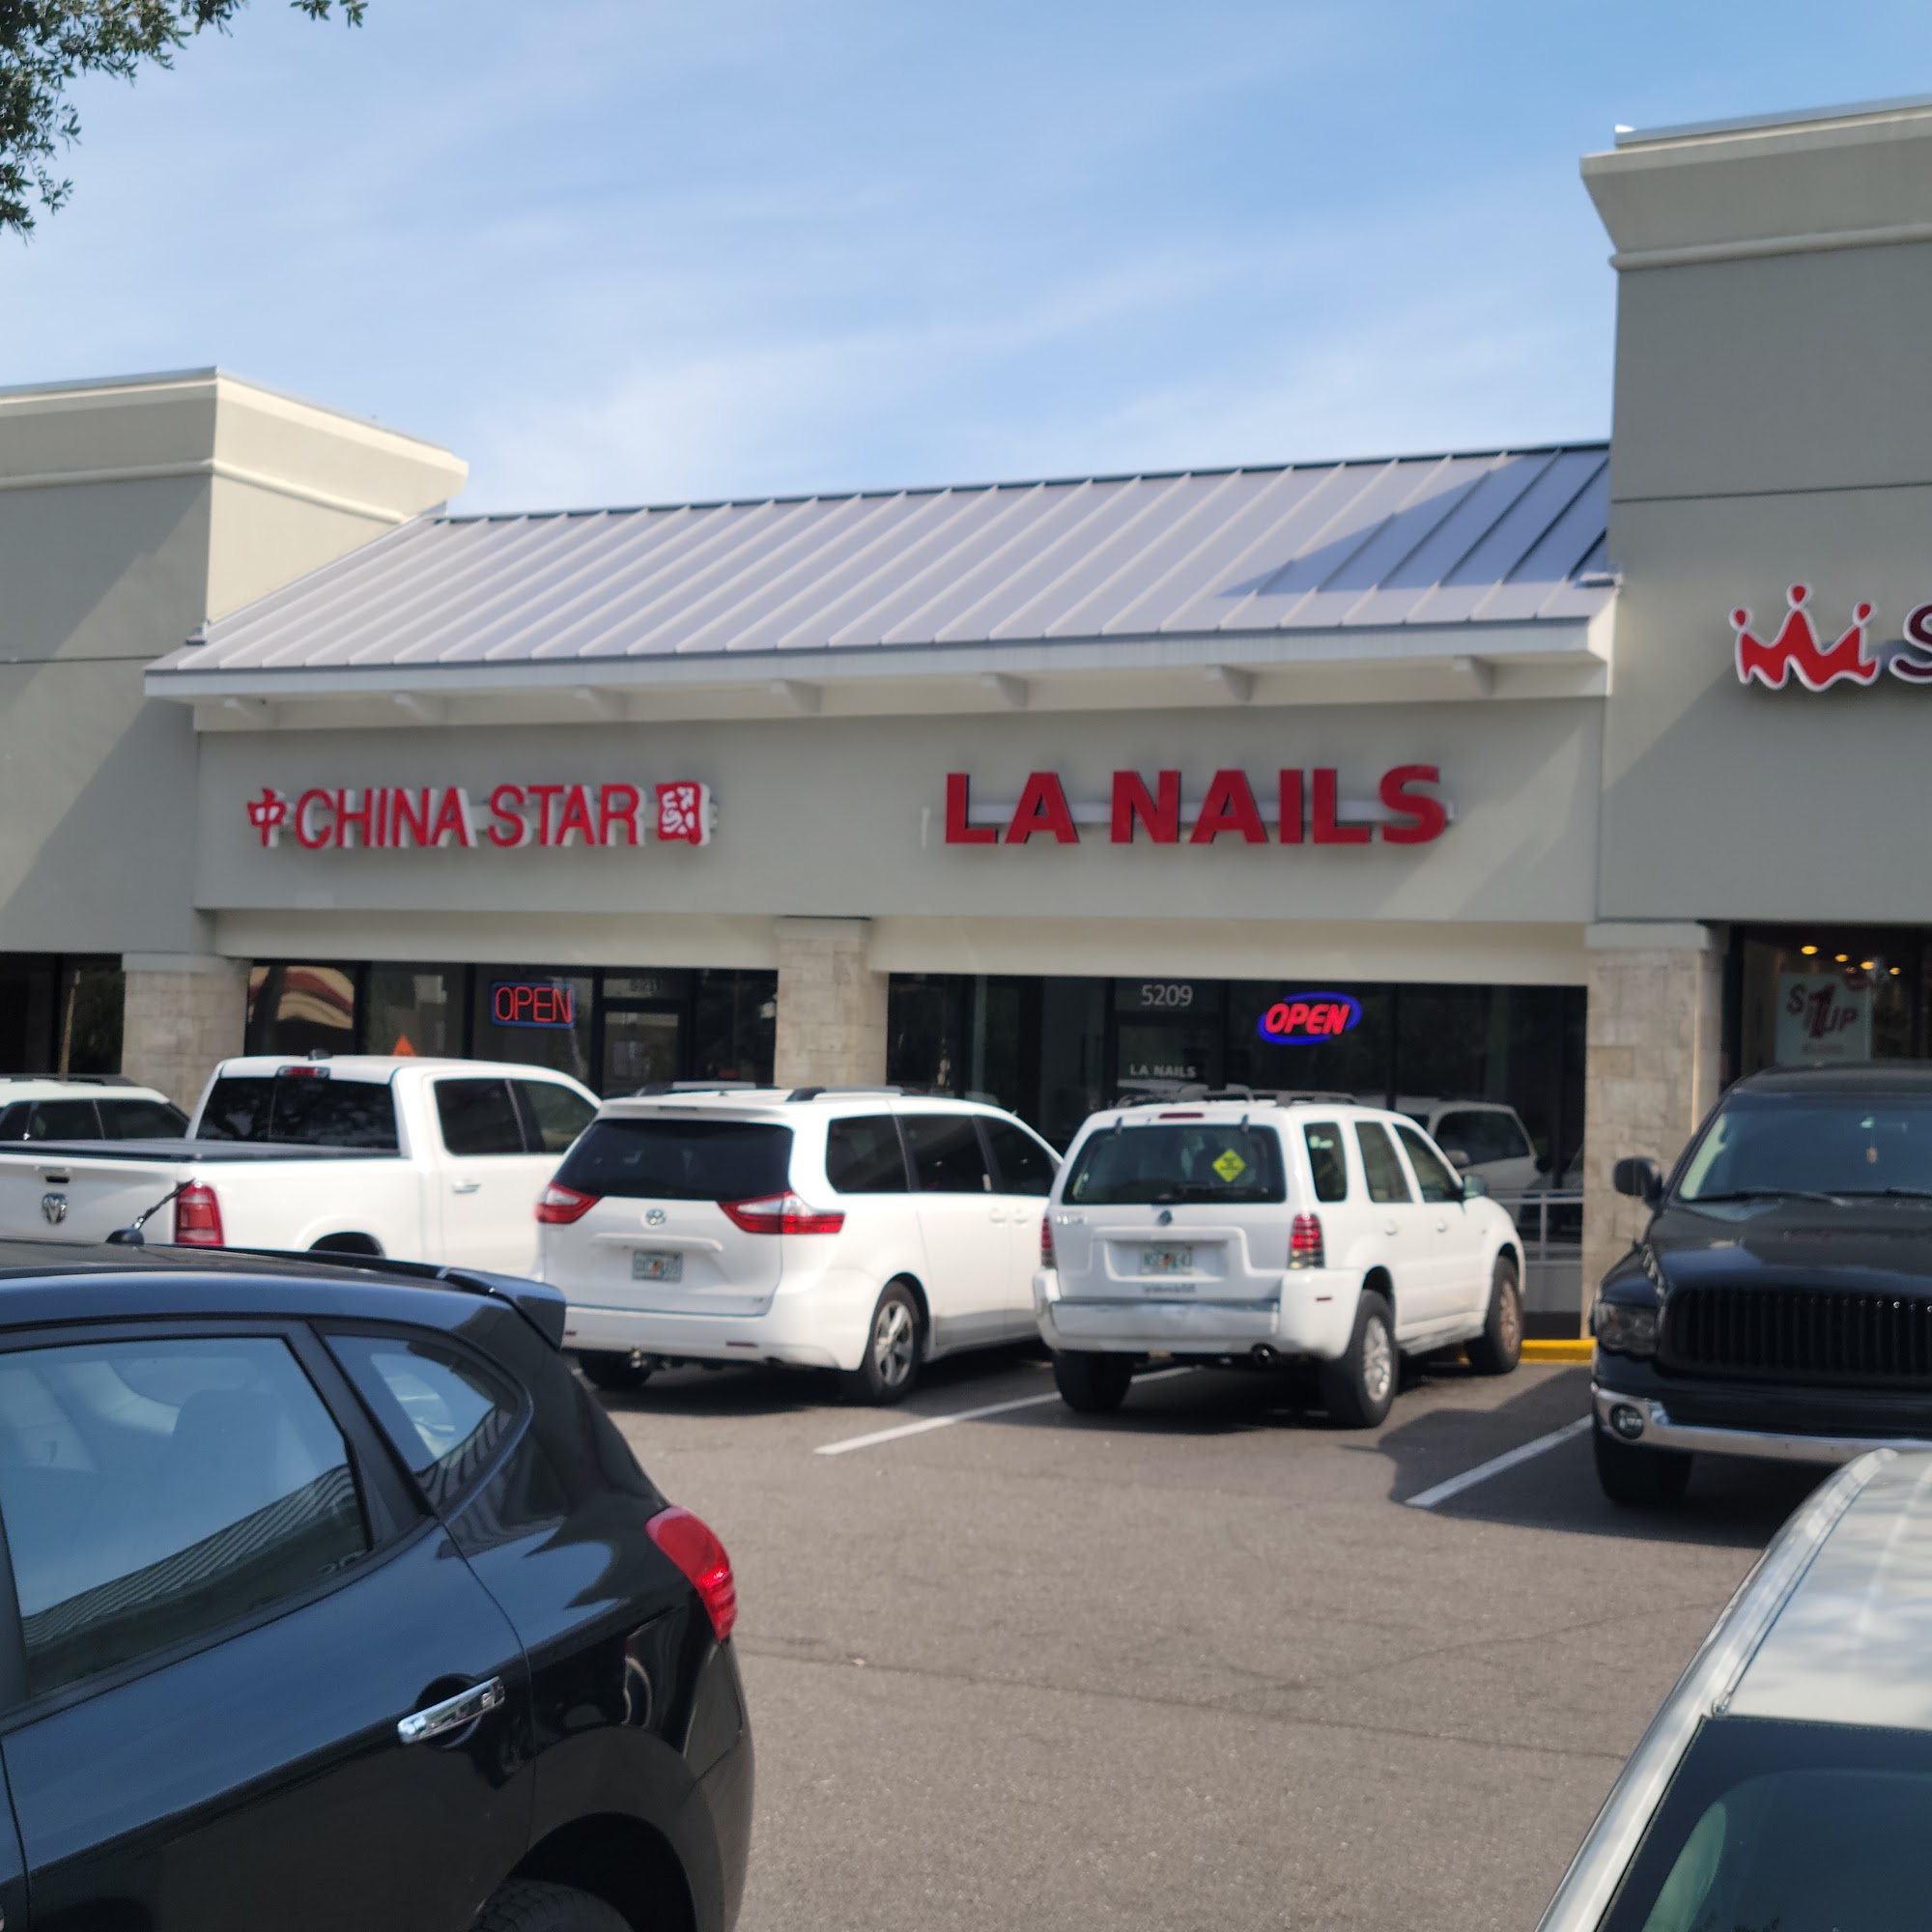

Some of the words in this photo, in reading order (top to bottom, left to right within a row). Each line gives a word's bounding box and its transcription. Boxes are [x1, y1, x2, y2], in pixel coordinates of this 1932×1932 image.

[295, 787, 469, 849] CHINA
[488, 783, 640, 848] STAR
[944, 771, 1080, 844] LA
[1110, 764, 1448, 845] NAILS
[494, 985, 572, 1024] OPEN
[1141, 983, 1194, 1007] 5209
[1264, 1002, 1350, 1036] OPEN
[1128, 1064, 1150, 1076] LA
[1152, 1065, 1198, 1079] NAILS
